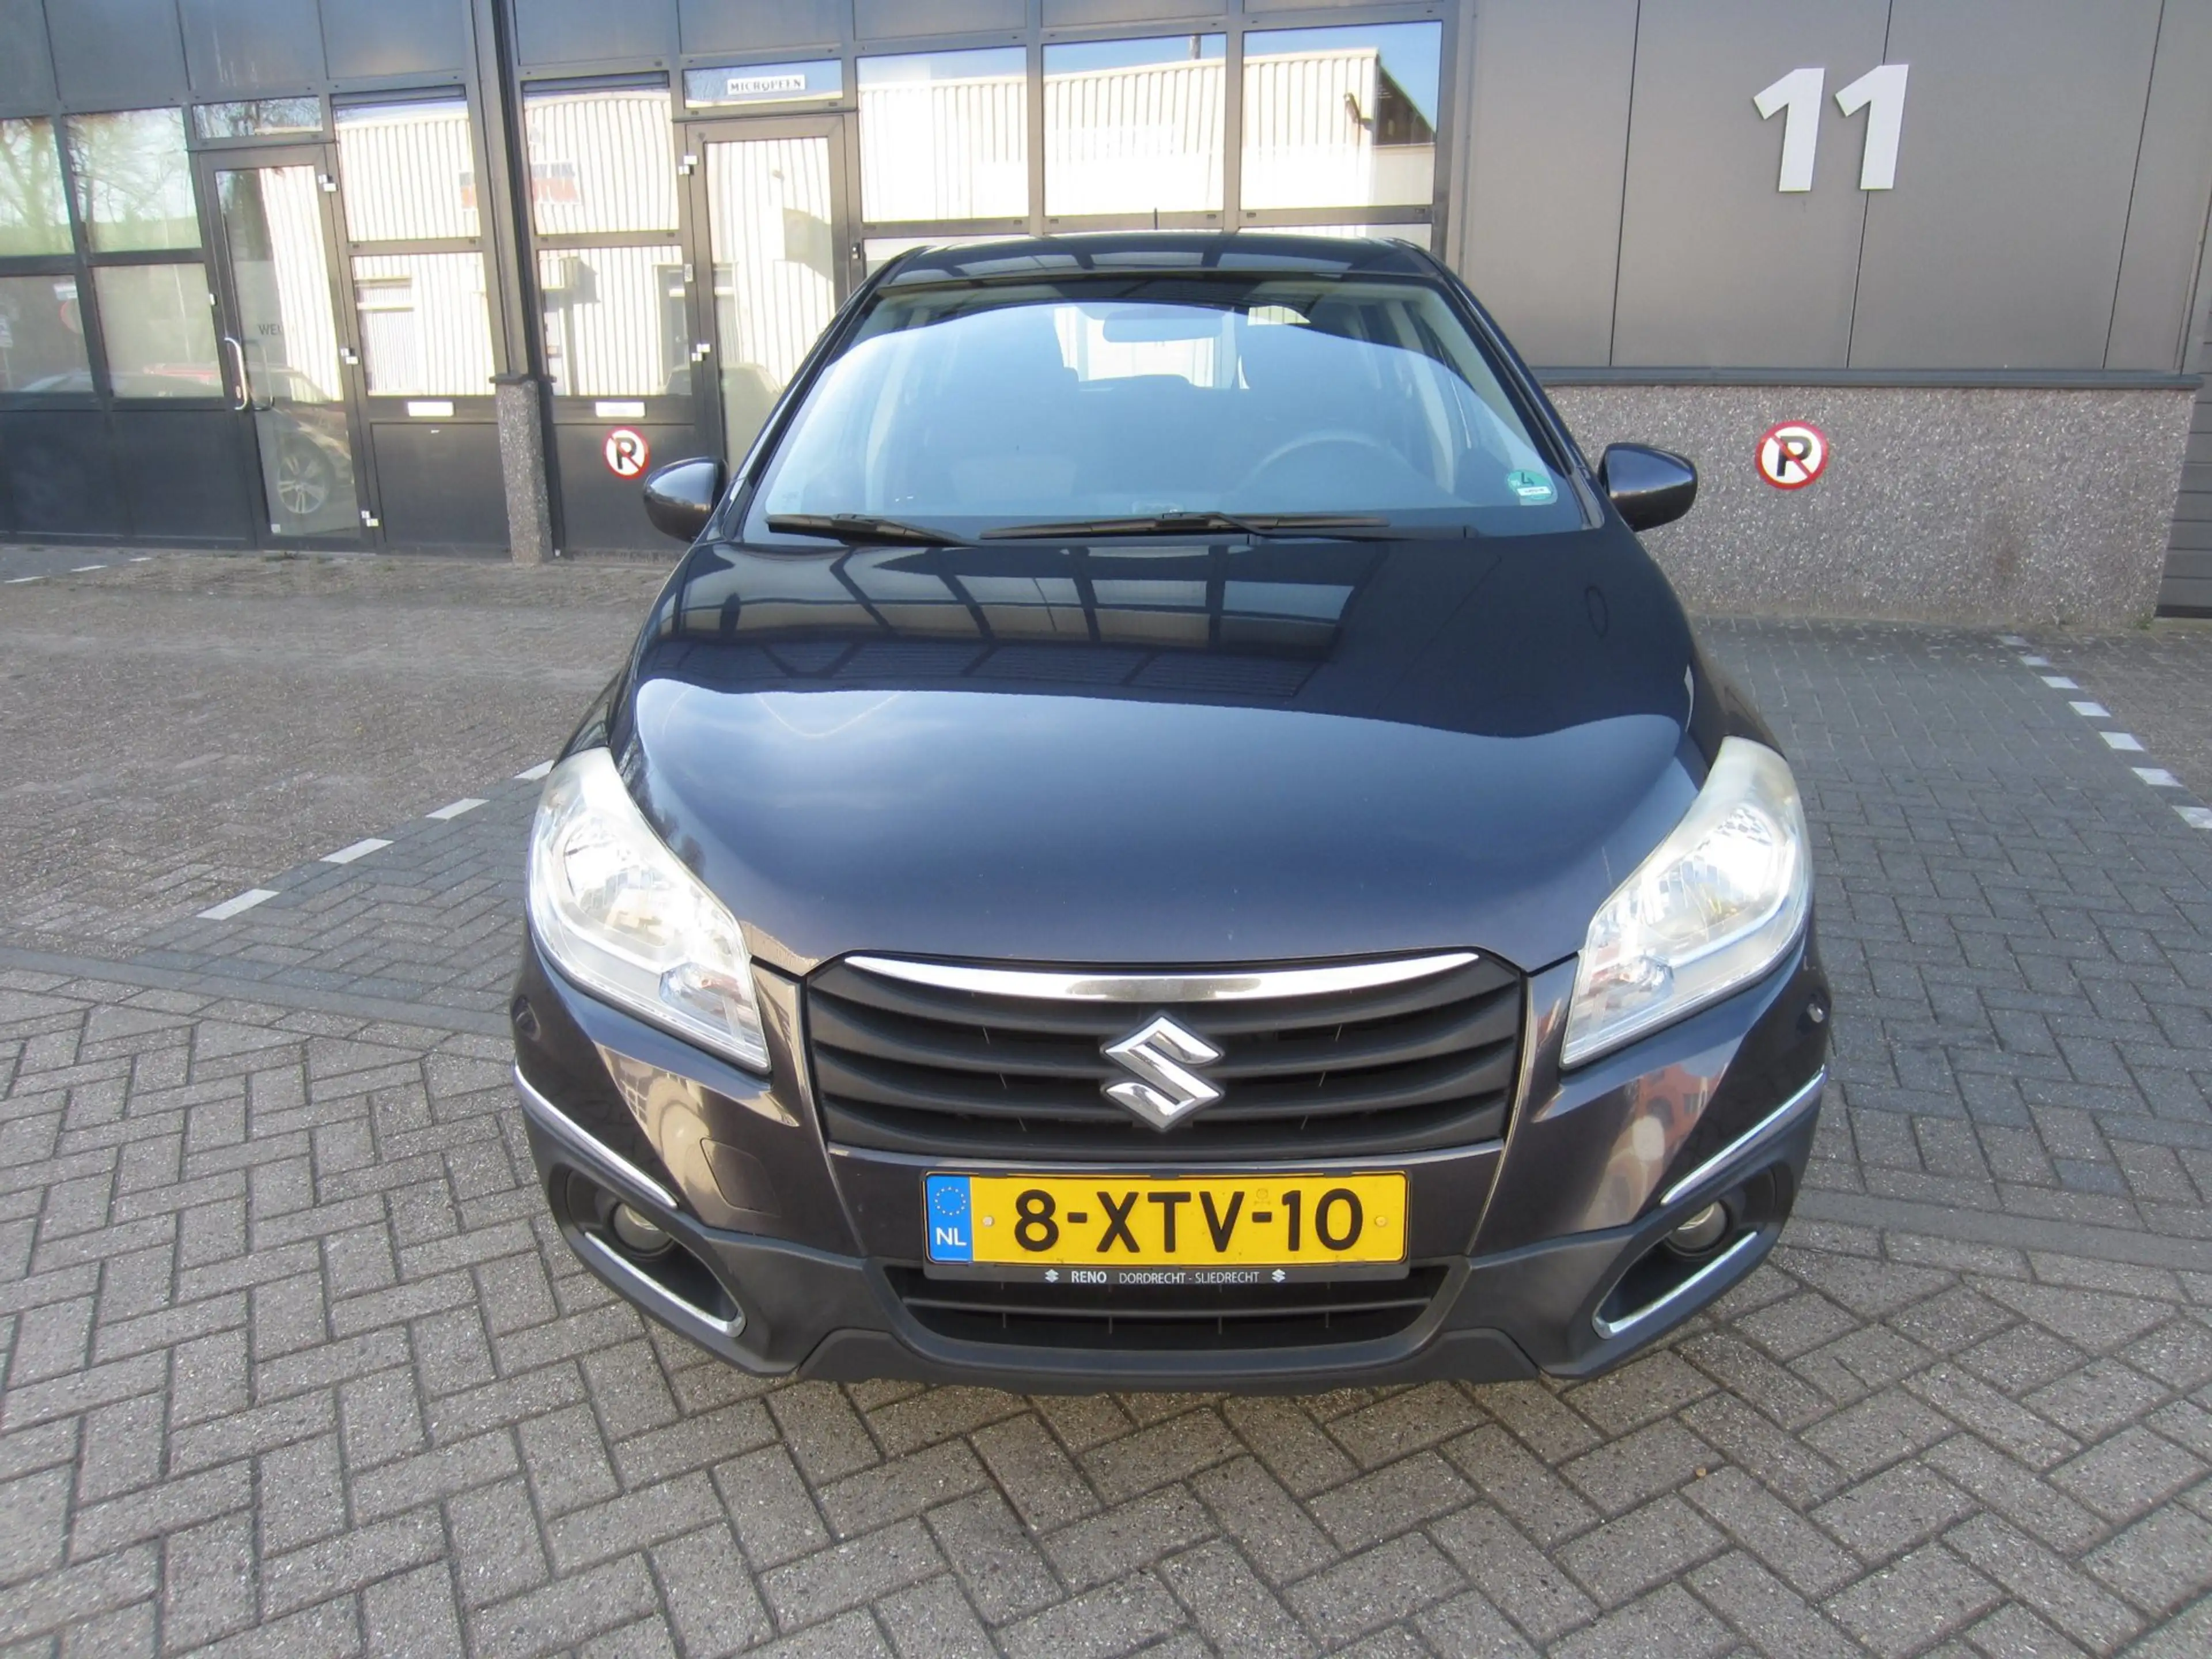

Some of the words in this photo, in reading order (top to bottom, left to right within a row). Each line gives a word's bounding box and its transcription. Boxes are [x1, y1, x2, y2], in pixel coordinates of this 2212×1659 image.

[1753, 65, 1909, 191] 11
[935, 1227, 967, 1247] NL
[1014, 1188, 1363, 1253] 8-XTV-10
[1071, 1270, 1107, 1284] RENO
[1119, 1271, 1186, 1284] DORDRECHT
[1195, 1271, 1260, 1284] SLIEDRECHT
